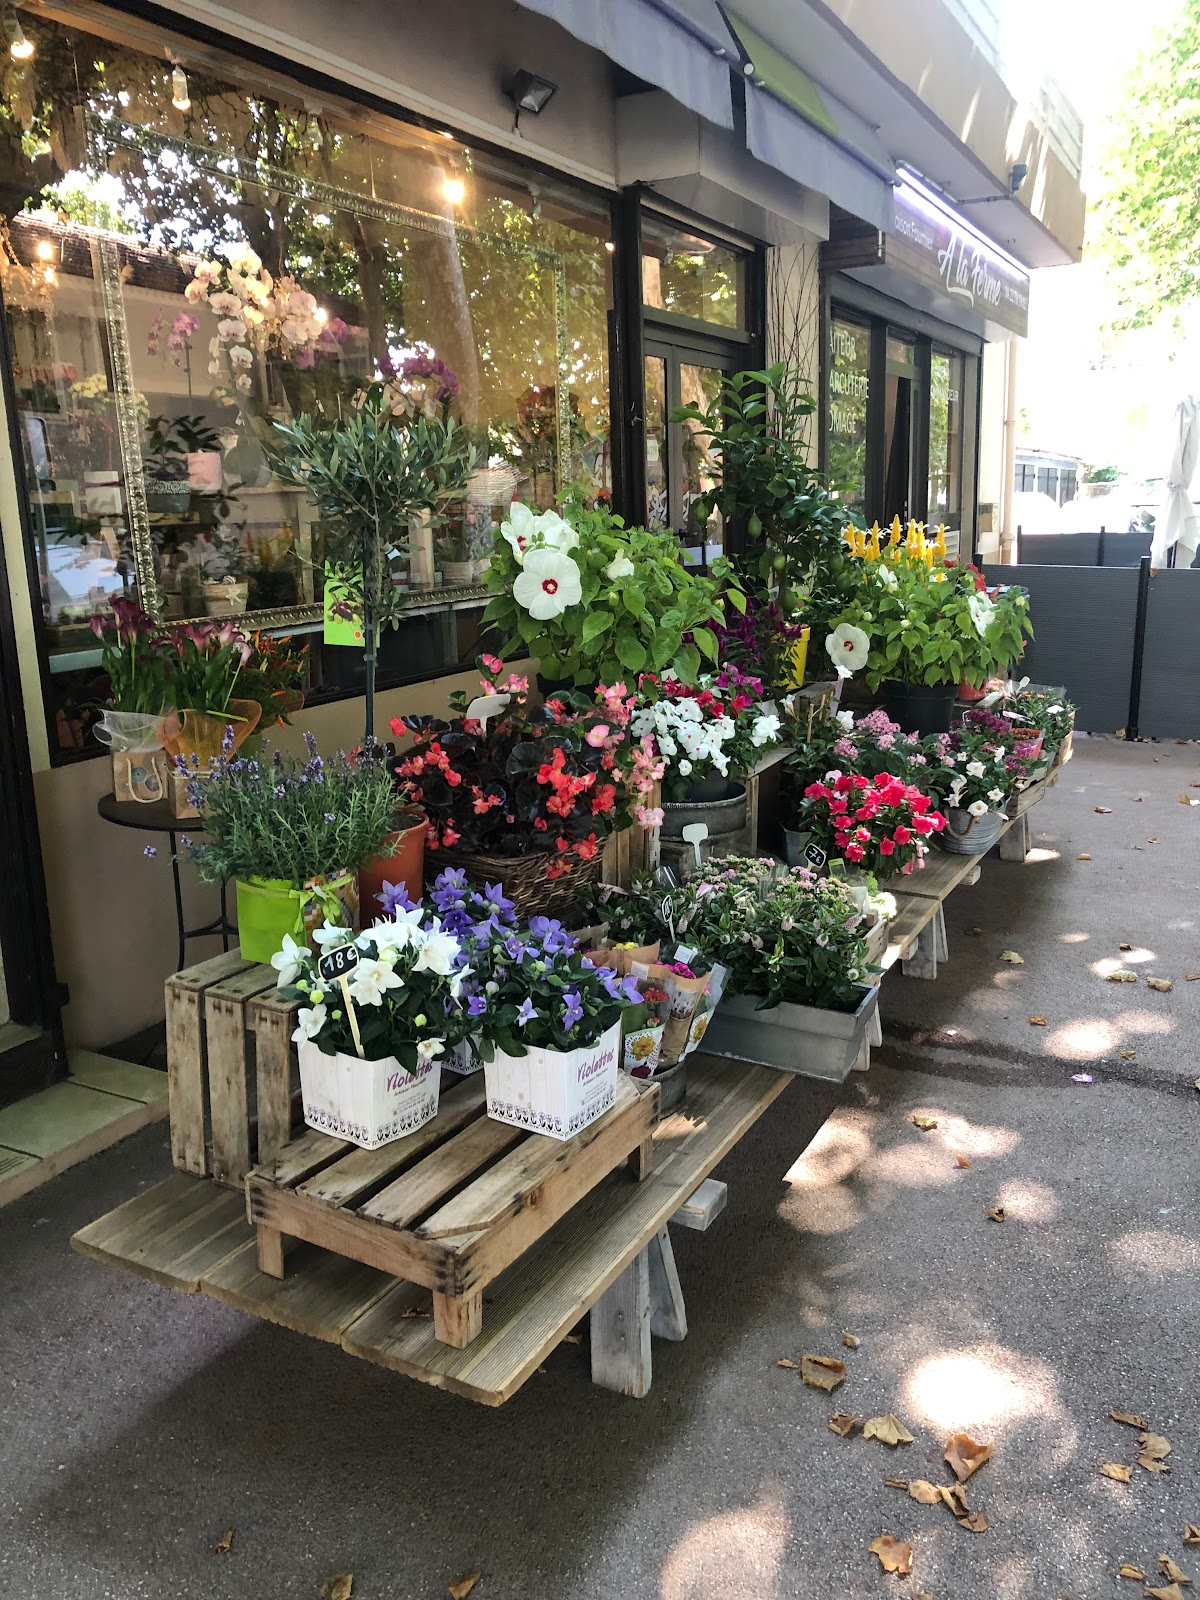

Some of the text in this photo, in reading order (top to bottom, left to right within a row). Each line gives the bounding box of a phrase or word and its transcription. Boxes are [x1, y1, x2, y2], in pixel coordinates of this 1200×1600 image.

[956, 239, 969, 288] la
[970, 249, 1001, 306] Ferme
[324, 947, 357, 972] 18€
[578, 1048, 615, 1083] Violettes
